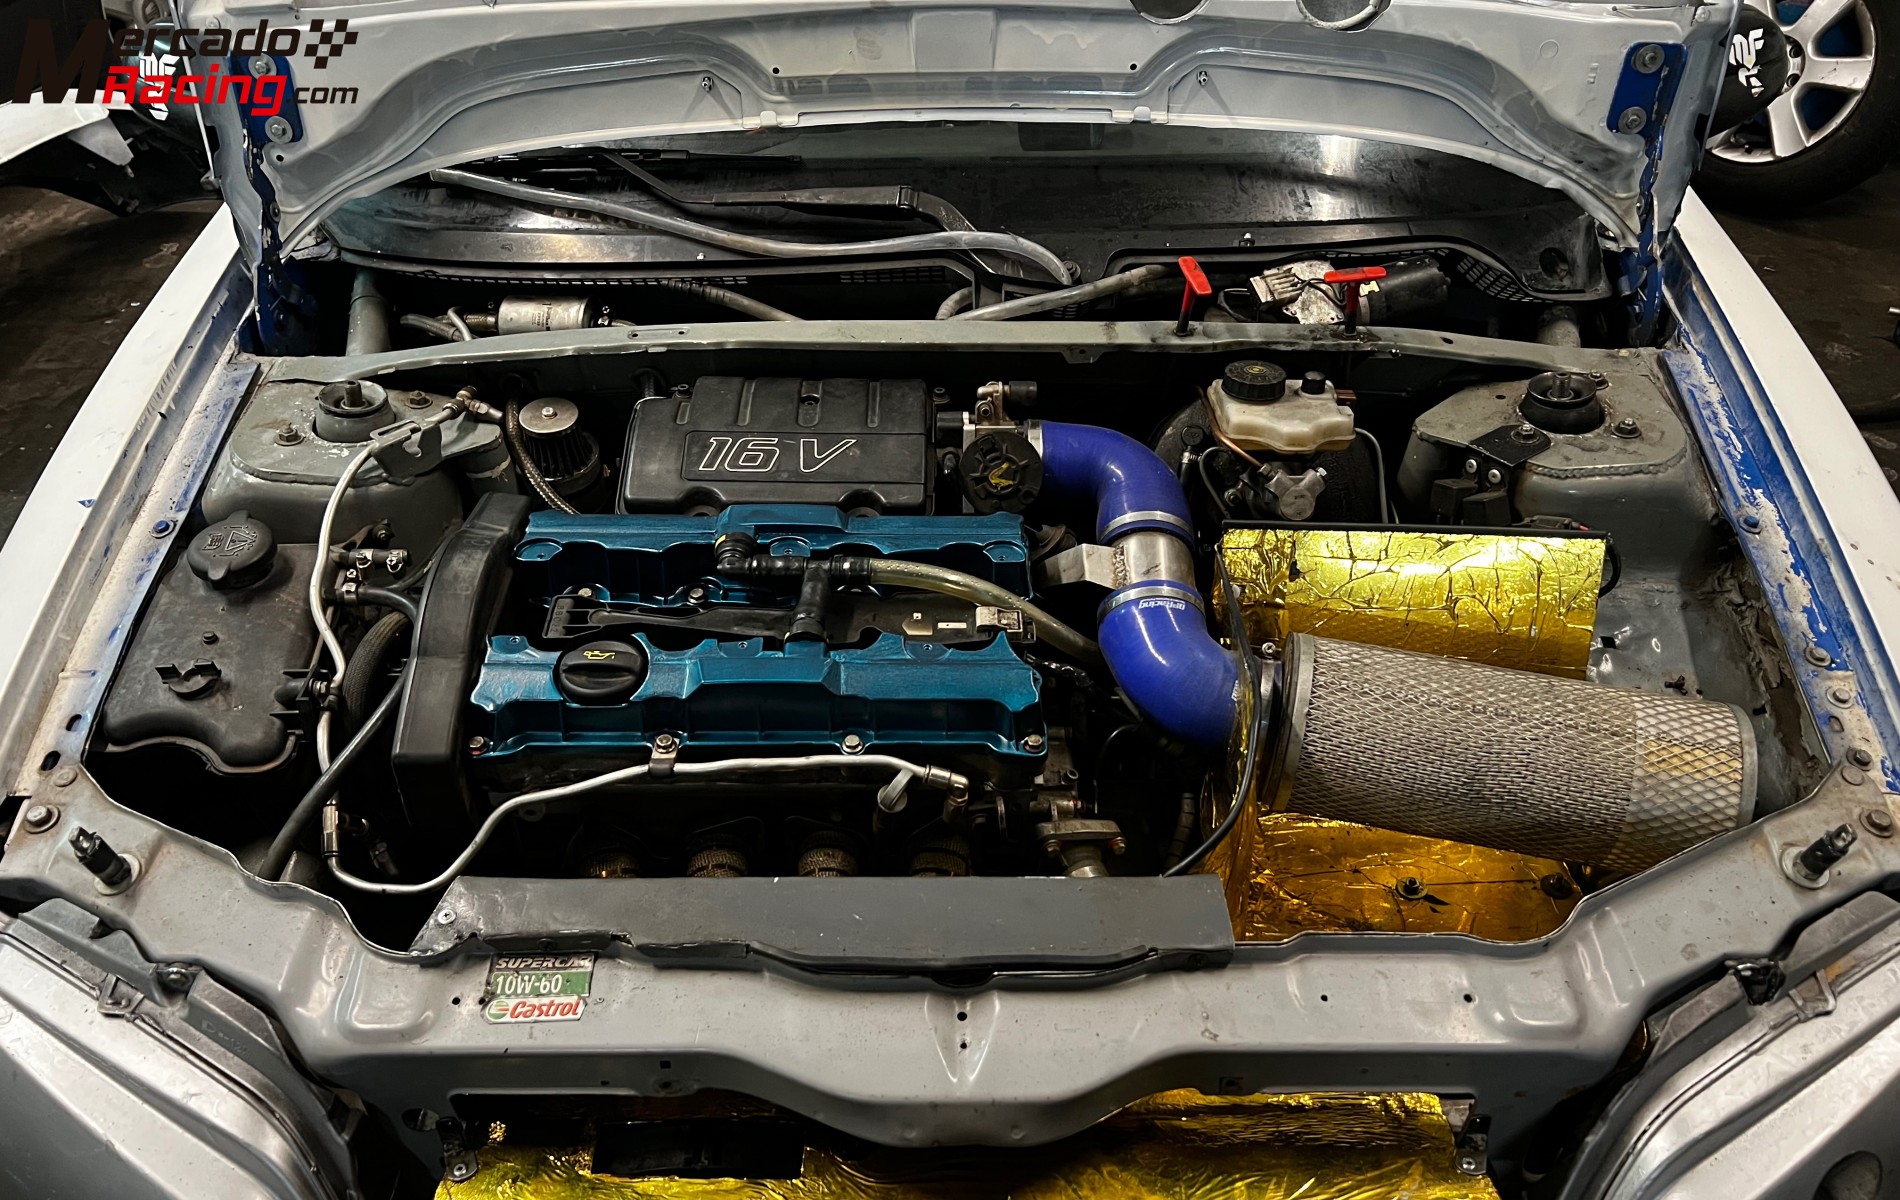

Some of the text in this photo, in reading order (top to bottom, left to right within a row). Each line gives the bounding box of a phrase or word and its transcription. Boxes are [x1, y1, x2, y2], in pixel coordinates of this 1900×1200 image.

[699, 437, 857, 472] 16 V
[496, 974, 563, 994] 10W-60
[509, 998, 581, 1019] Castrol
